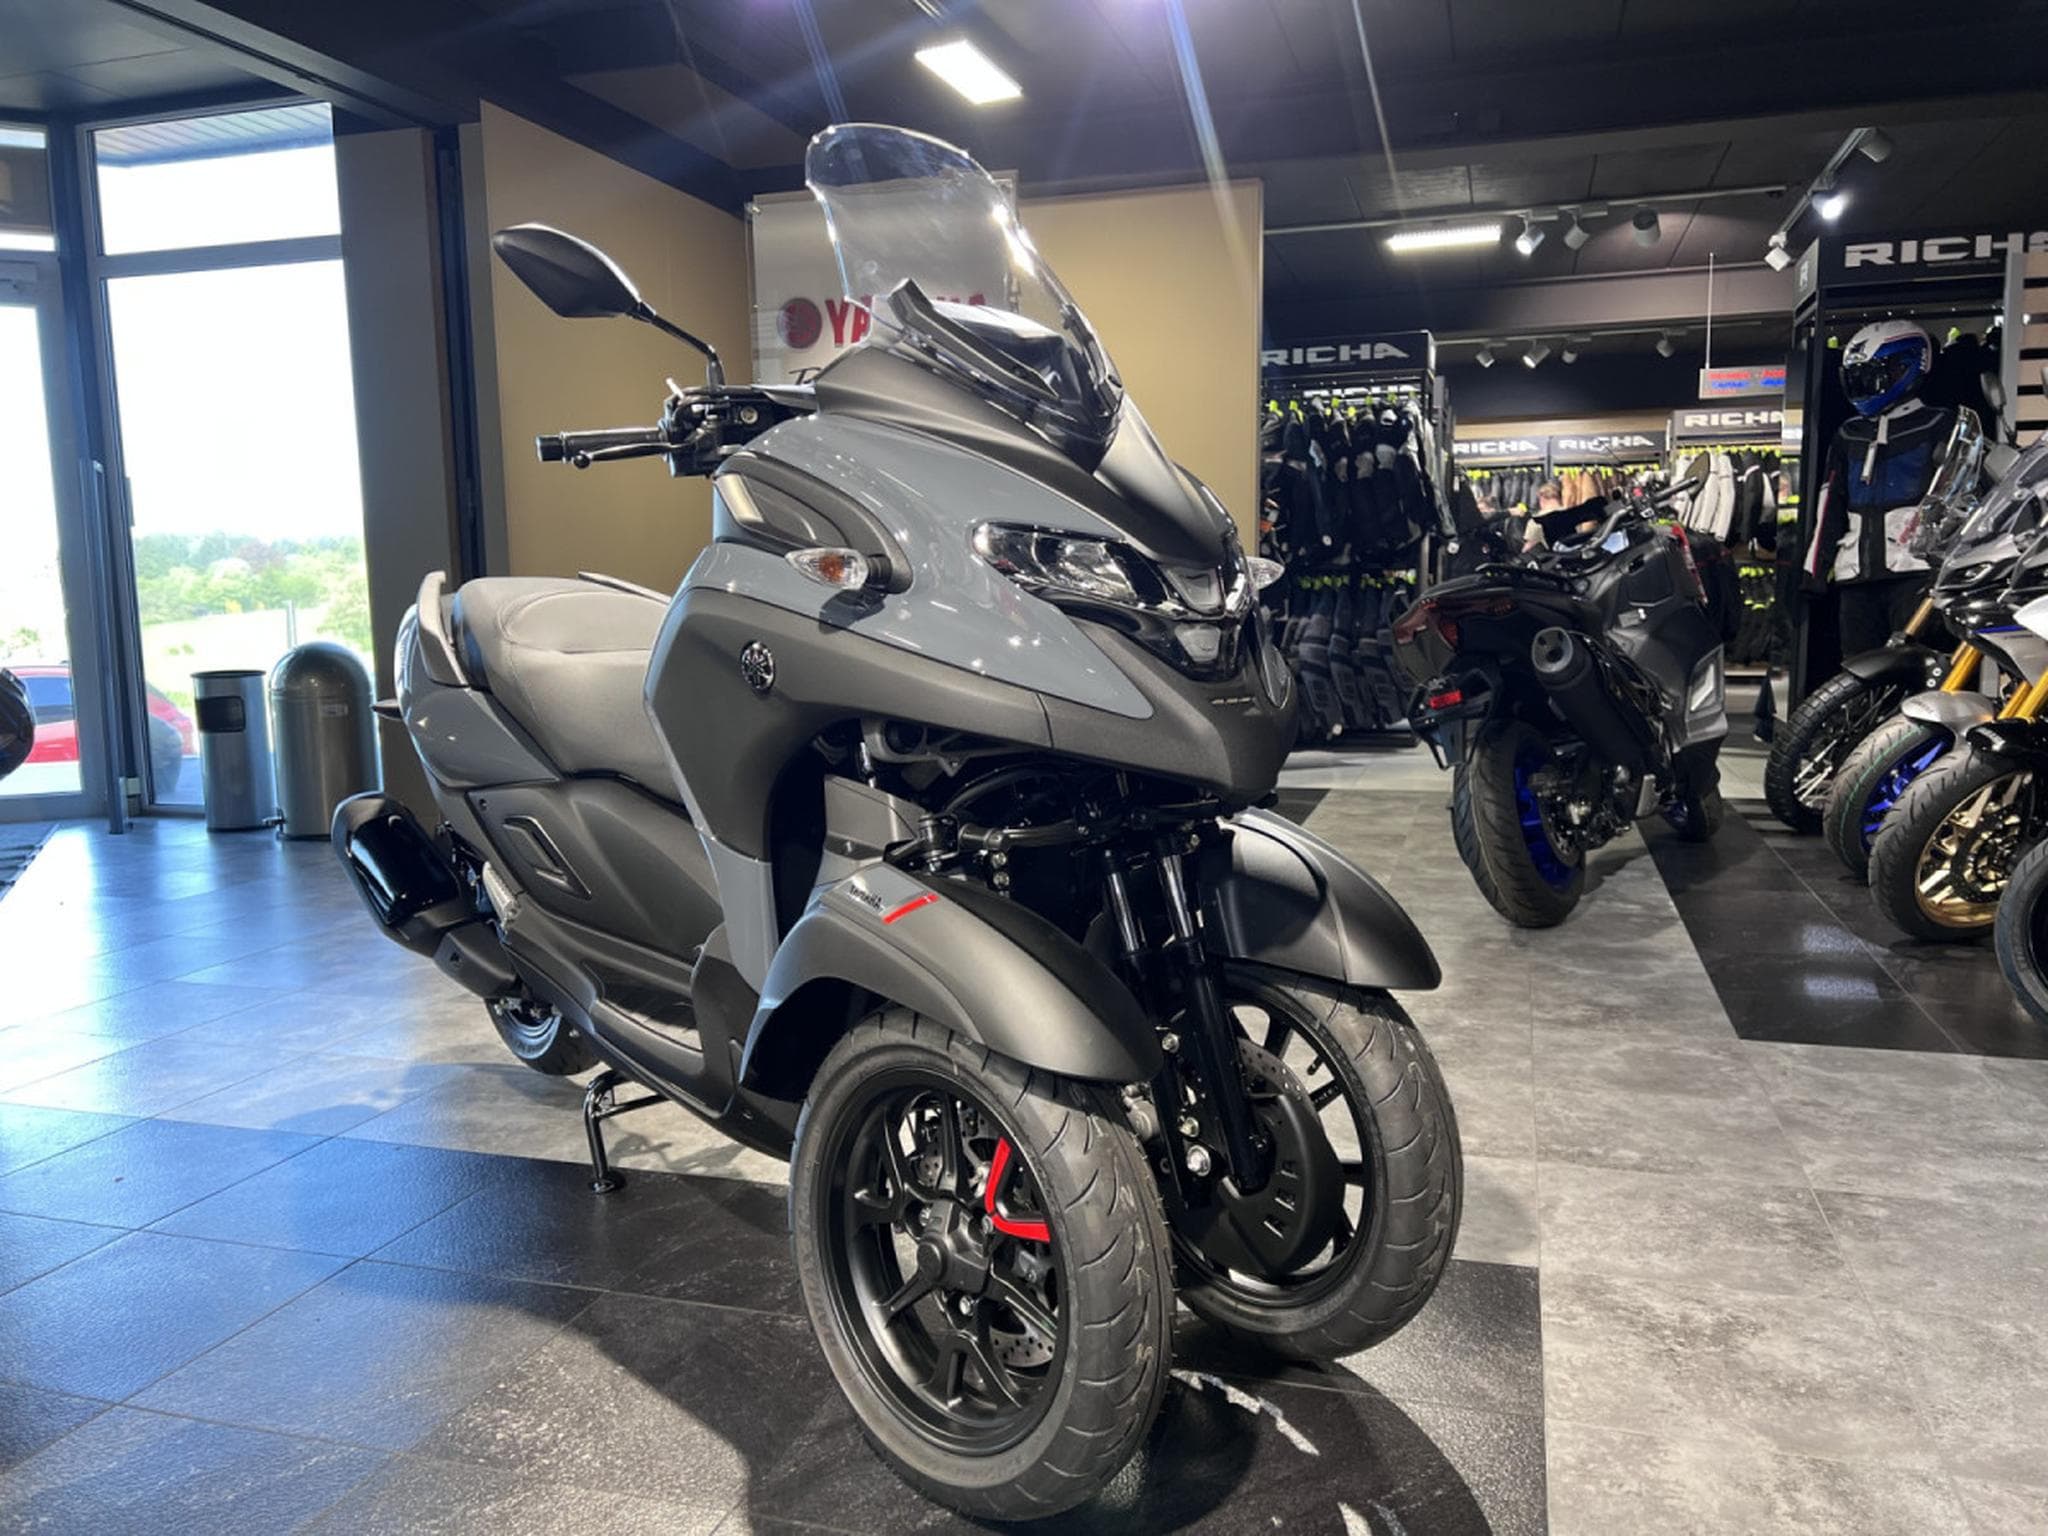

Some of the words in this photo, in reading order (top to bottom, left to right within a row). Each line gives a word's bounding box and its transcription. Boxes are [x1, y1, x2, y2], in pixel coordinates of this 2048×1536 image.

[1261, 342, 1410, 367] RICHA
[1453, 439, 1539, 455] RICHA
[1558, 434, 1655, 452] RICHA
